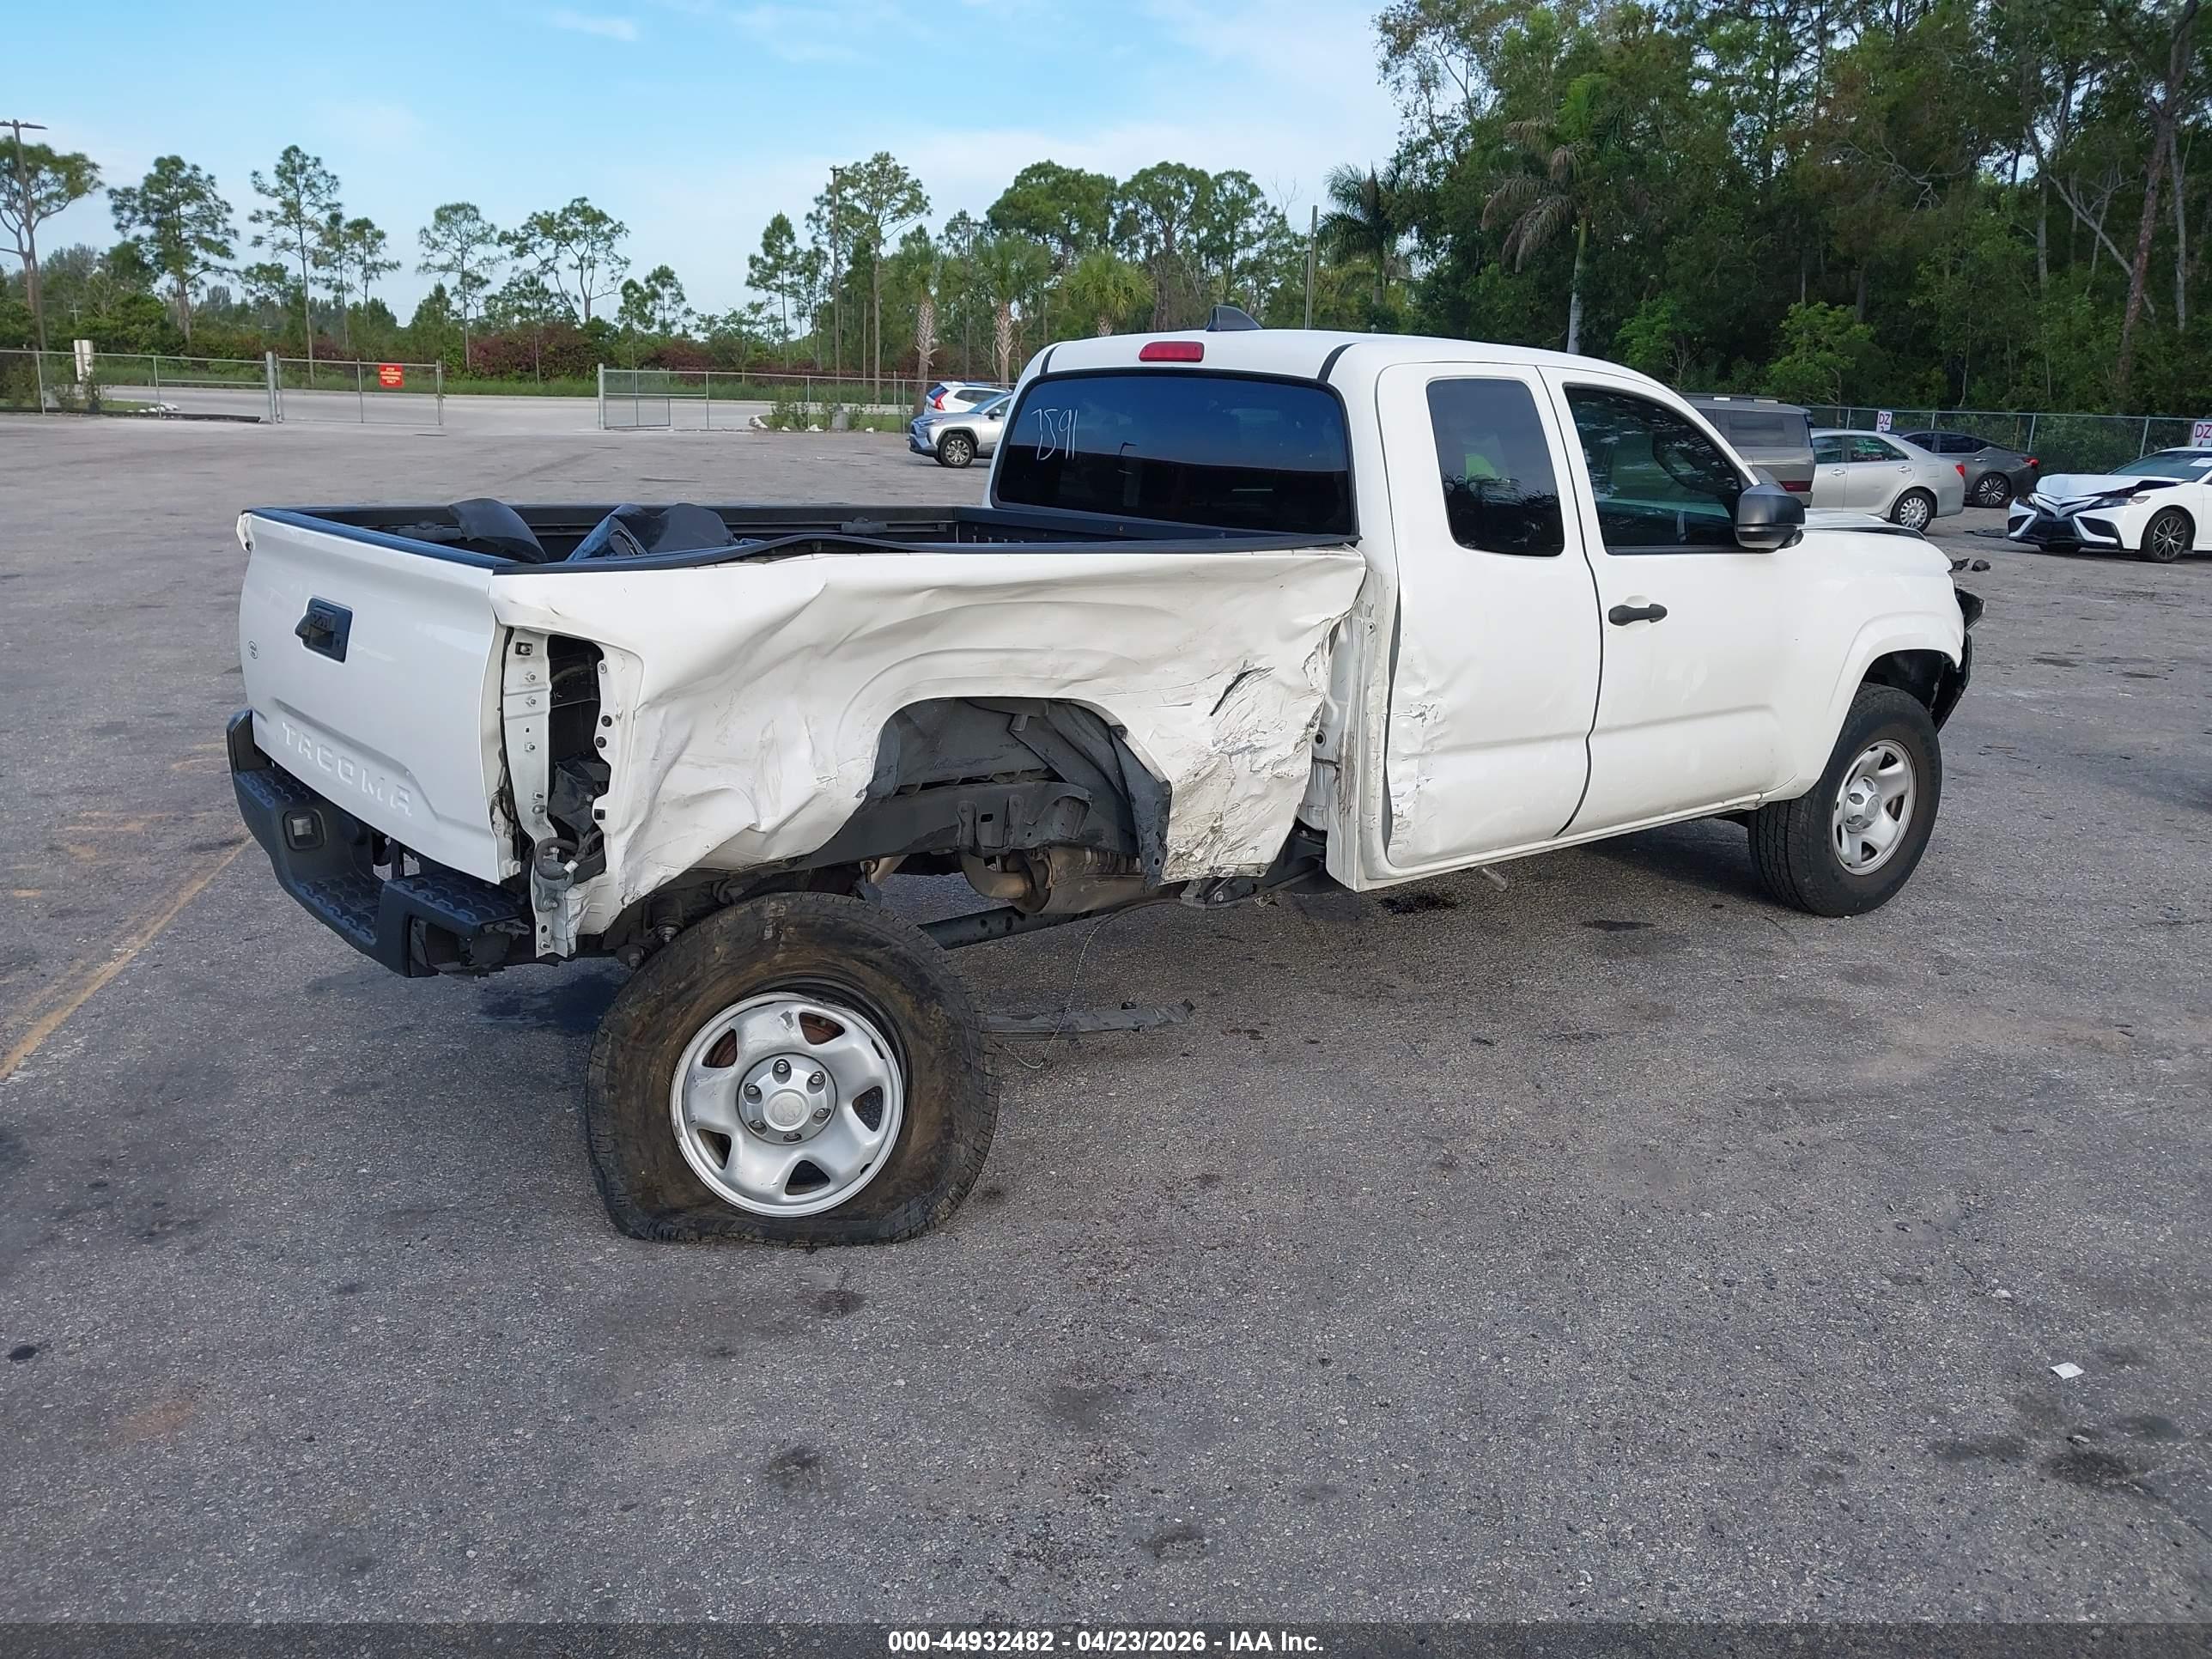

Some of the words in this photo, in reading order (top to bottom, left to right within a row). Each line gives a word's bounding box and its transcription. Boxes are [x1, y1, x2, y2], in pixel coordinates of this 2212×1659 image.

[1878, 412, 1891, 426] DZ
[2195, 424, 2212, 439] DZ
[282, 721, 412, 817] TACOMA
